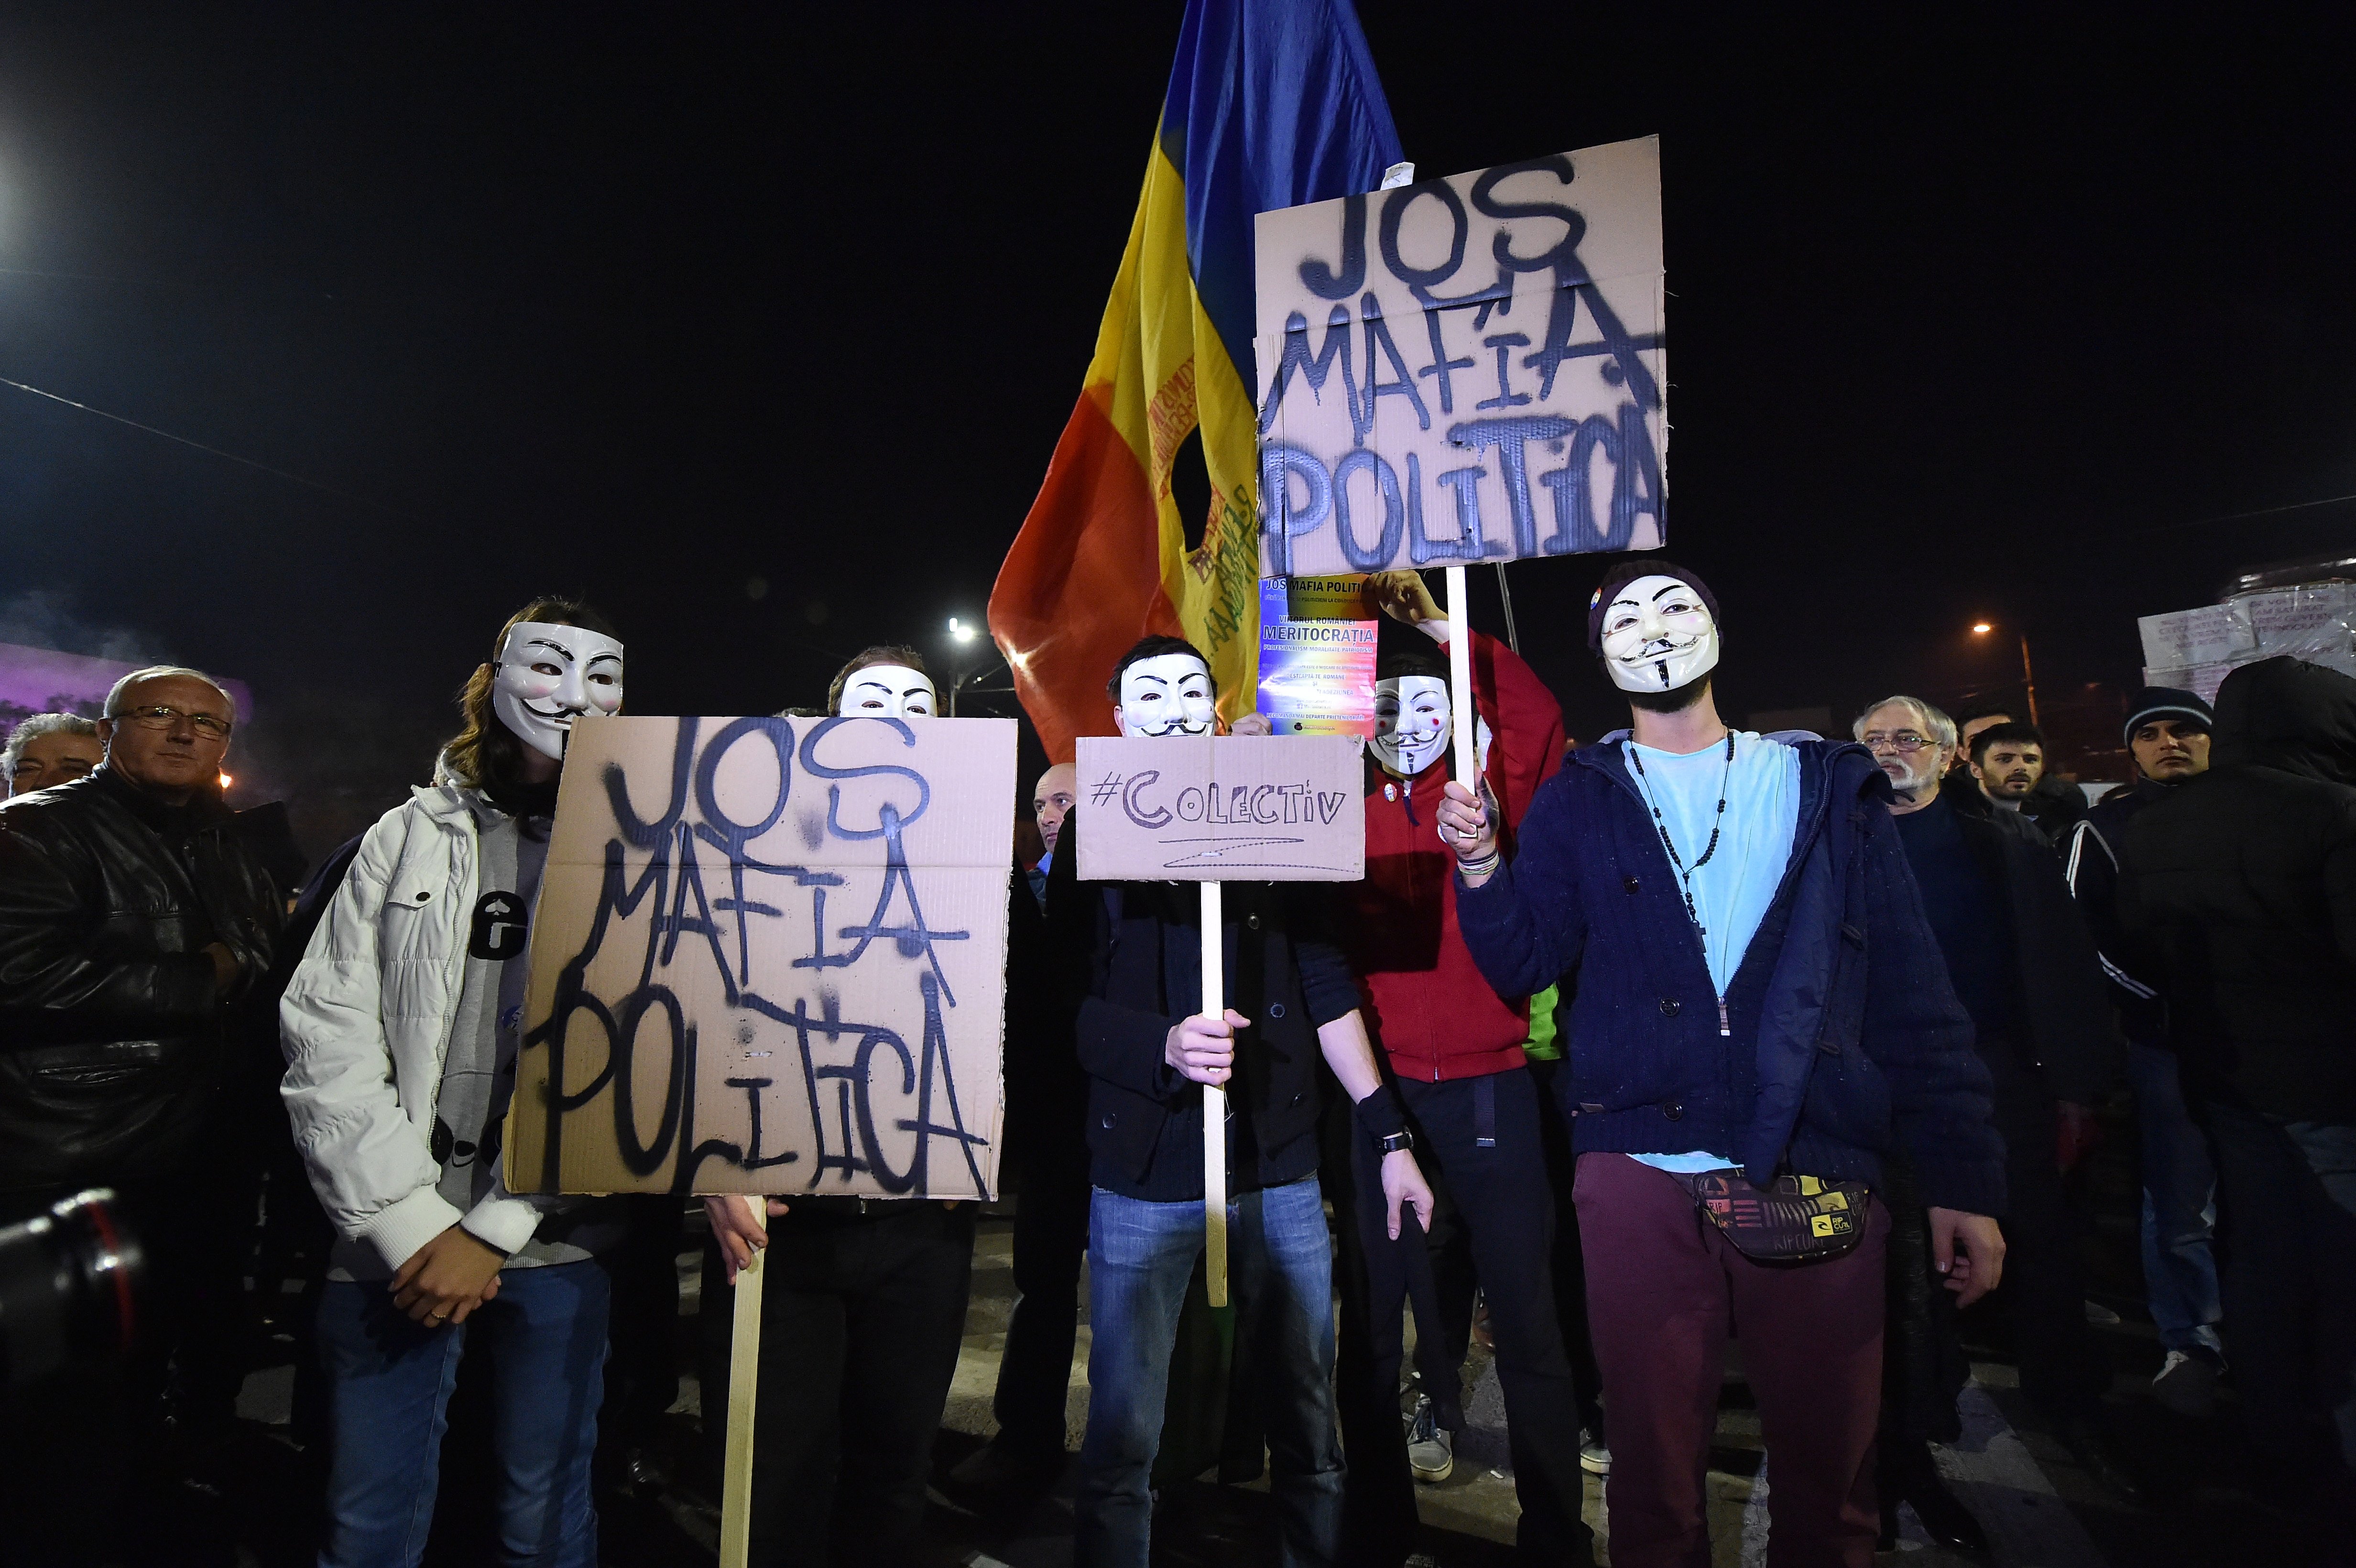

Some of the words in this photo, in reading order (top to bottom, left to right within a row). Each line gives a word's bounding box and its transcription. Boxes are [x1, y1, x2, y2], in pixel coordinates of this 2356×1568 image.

[1298, 154, 1586, 300] JOS
[1260, 251, 1666, 436] MAFIA
[1259, 404, 1667, 577] POLITICA
[1264, 626, 1374, 646] MERITOCRAȚIA
[1266, 579, 1286, 590] JOS
[1289, 580, 1324, 592] MAFIA
[1327, 581, 1361, 593] POLITI
[1279, 615, 1314, 623] VIITORUL
[601, 716, 929, 848] JOS
[577, 802, 970, 1007] MAFIA
[524, 971, 990, 1201] POLITICA
[1709, 1202, 1723, 1213] RIP
